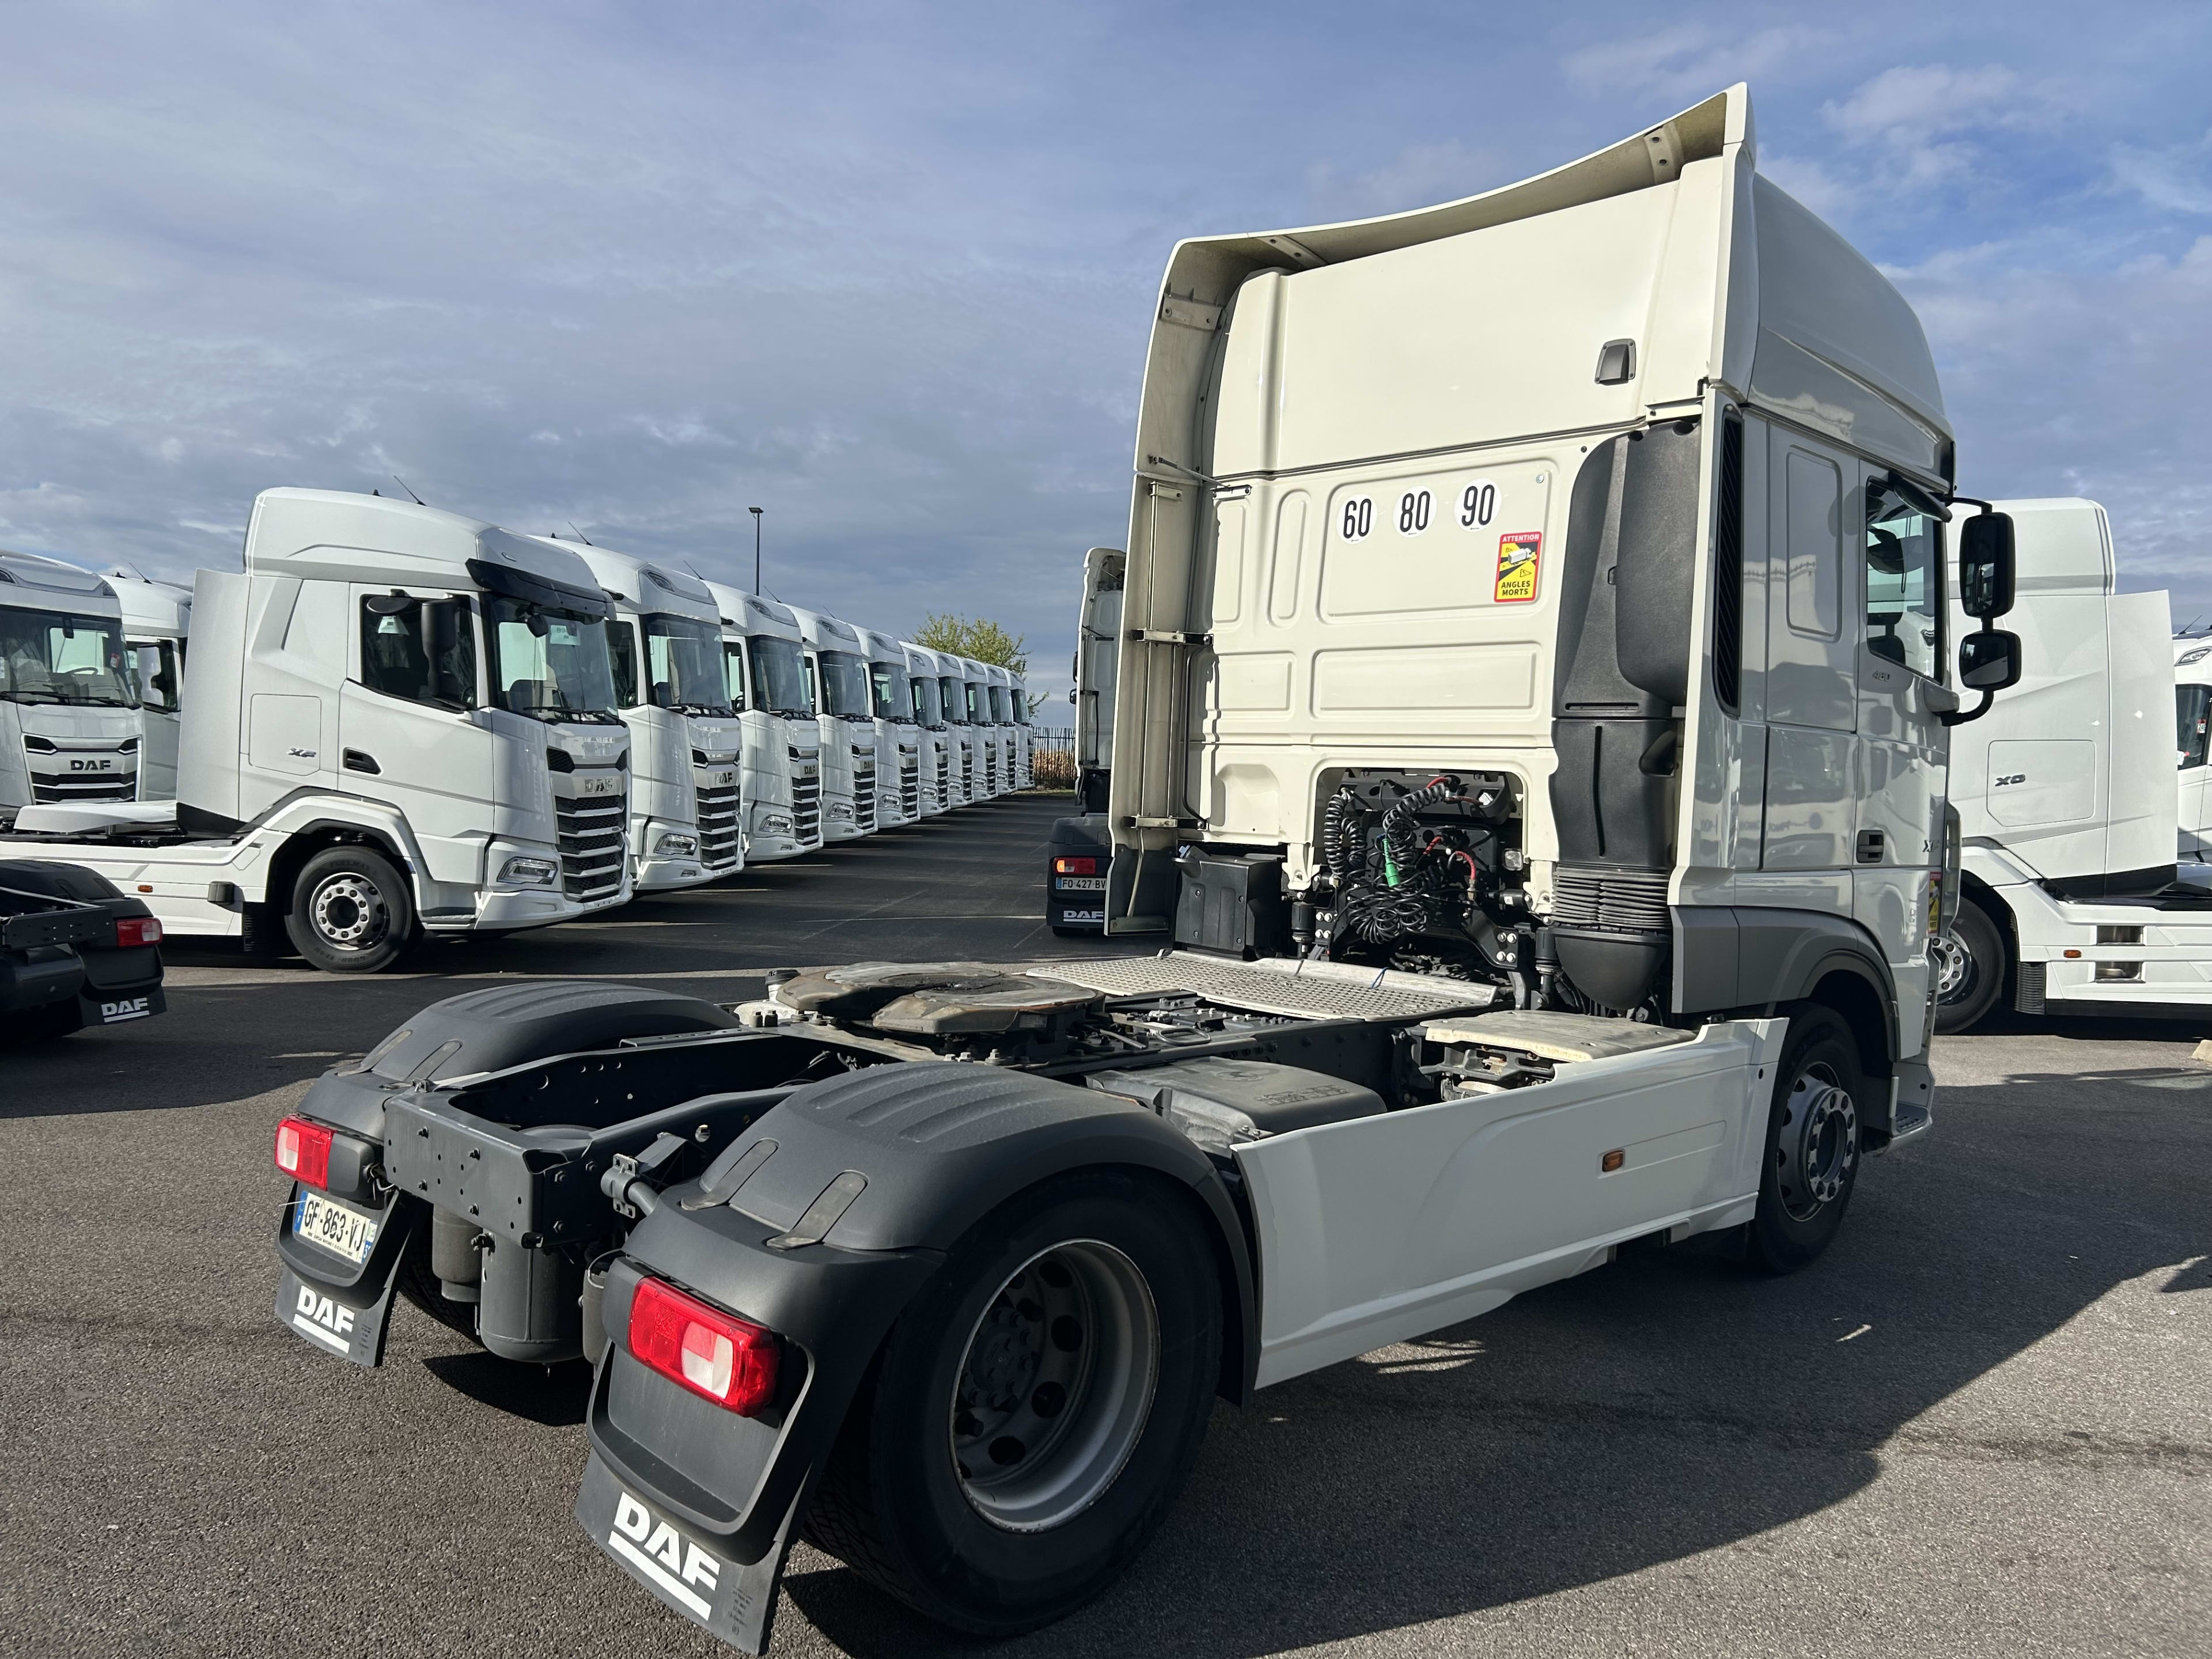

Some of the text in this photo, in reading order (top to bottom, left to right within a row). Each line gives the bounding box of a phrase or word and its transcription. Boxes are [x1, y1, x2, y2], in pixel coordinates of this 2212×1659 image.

[1343, 484, 1495, 539] 60 80 90
[1502, 534, 1540, 542] ATTENTION
[1501, 581, 1531, 589] ANGLES
[70, 760, 111, 770] DAF
[804, 765, 816, 775] DAF
[715, 772, 733, 784] DAF
[585, 779, 613, 793] DAF
[1922, 840, 1940, 853] XF
[101, 997, 148, 1016] DAF
[297, 1285, 355, 1333] DAF
[613, 1491, 720, 1591] DAF
